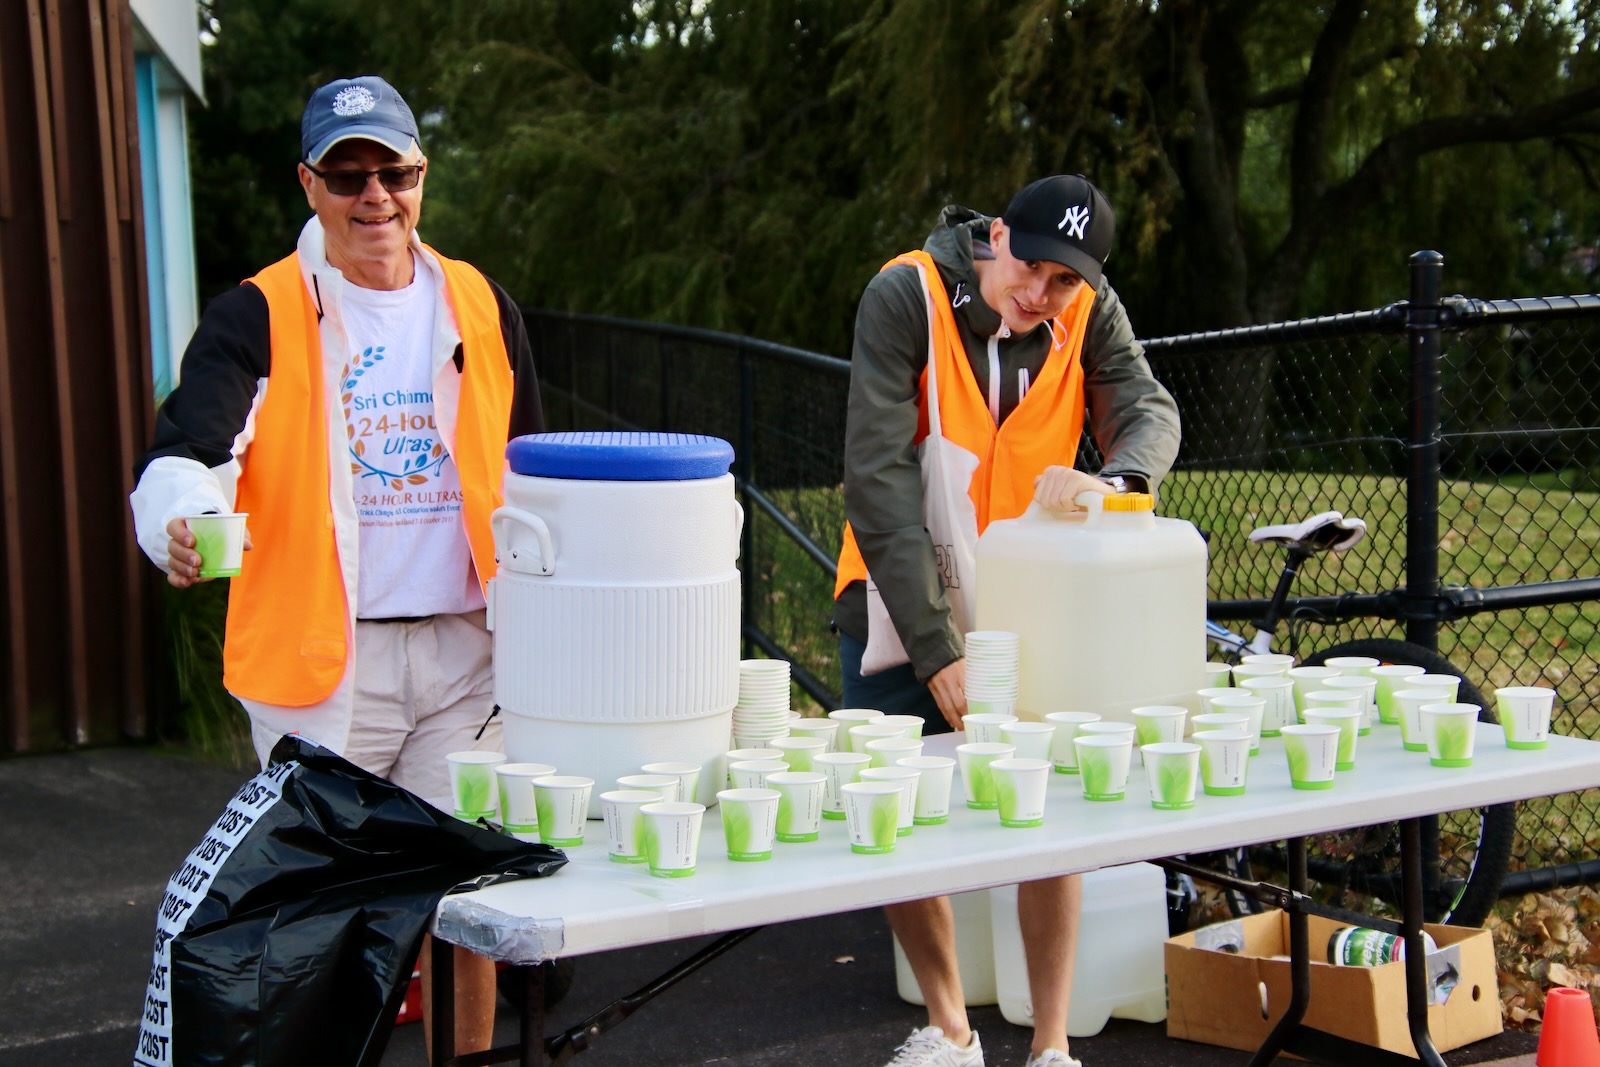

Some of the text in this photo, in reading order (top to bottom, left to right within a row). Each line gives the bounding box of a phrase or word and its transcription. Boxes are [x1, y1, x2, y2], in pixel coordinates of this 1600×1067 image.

[1058, 205, 1090, 240] NY
[353, 389, 434, 411] Sri Chinm
[383, 435, 433, 455] Ulras
[353, 494, 377, 506] -24
[381, 492, 413, 506] HOUR
[446, 504, 460, 512] Event
[216, 808, 254, 837] COST
[196, 836, 231, 866] COST
[162, 893, 192, 923] COST
[145, 994, 168, 1026] COST
[141, 1029, 169, 1062] COST
